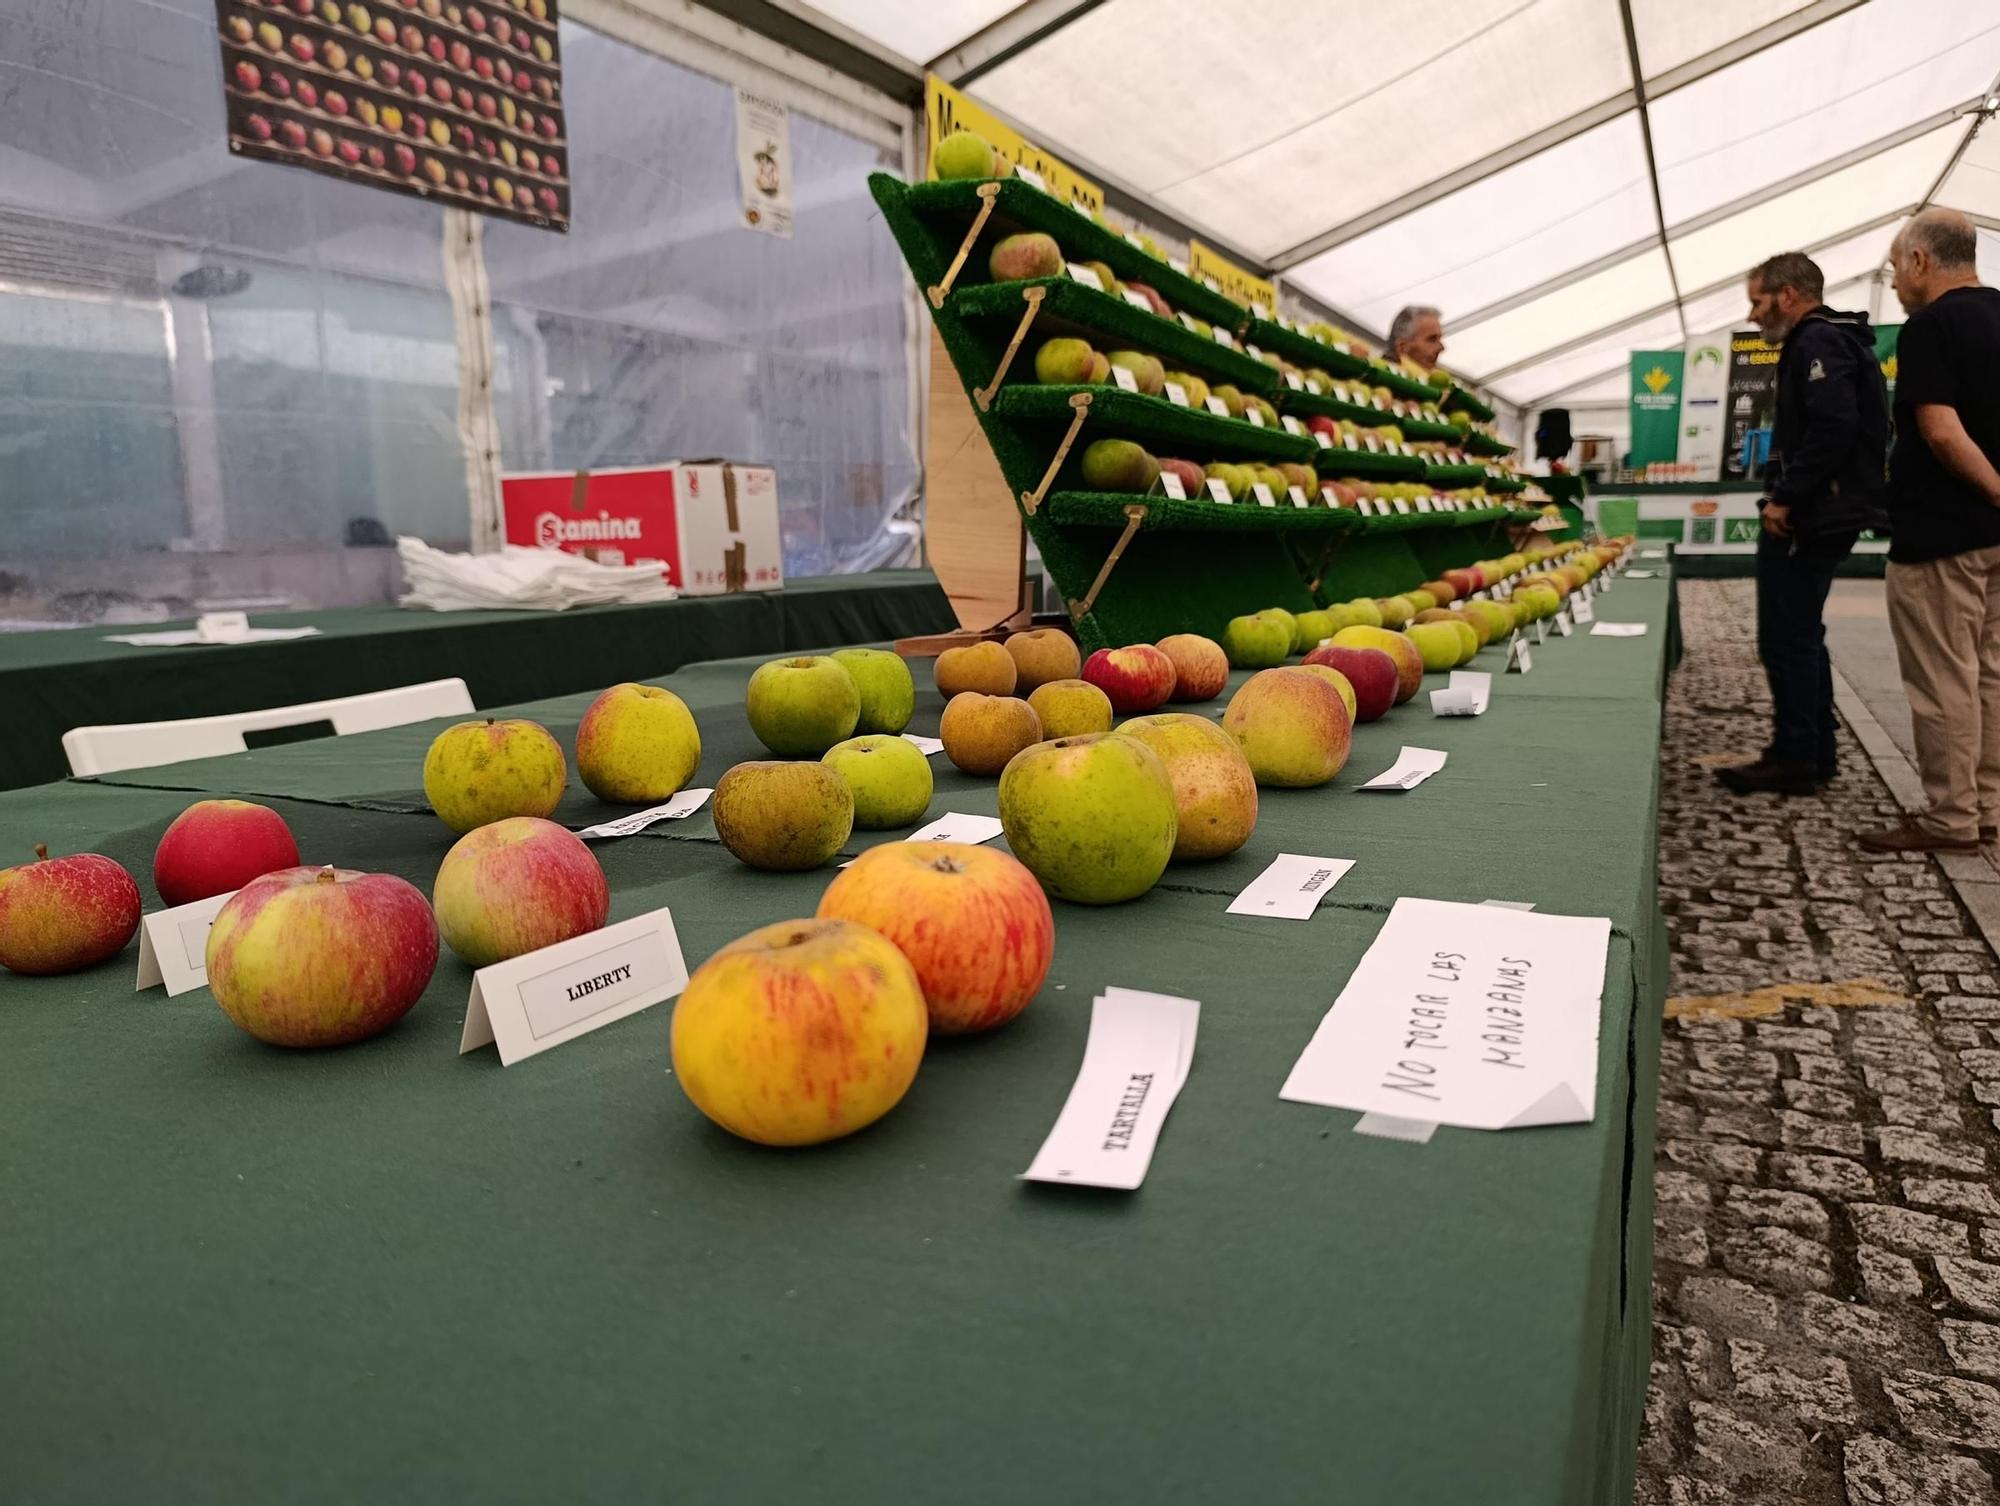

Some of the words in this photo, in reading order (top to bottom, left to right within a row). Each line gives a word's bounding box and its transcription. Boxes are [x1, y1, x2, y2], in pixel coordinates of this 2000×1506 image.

[535, 510, 641, 549] Stamina
[567, 963, 633, 1003] LIBERTY
[1426, 950, 1469, 984] LAS
[1402, 993, 1451, 1052] TOCAR
[1380, 1060, 1442, 1102] NO
[1101, 1071, 1155, 1153] TARTALLA
